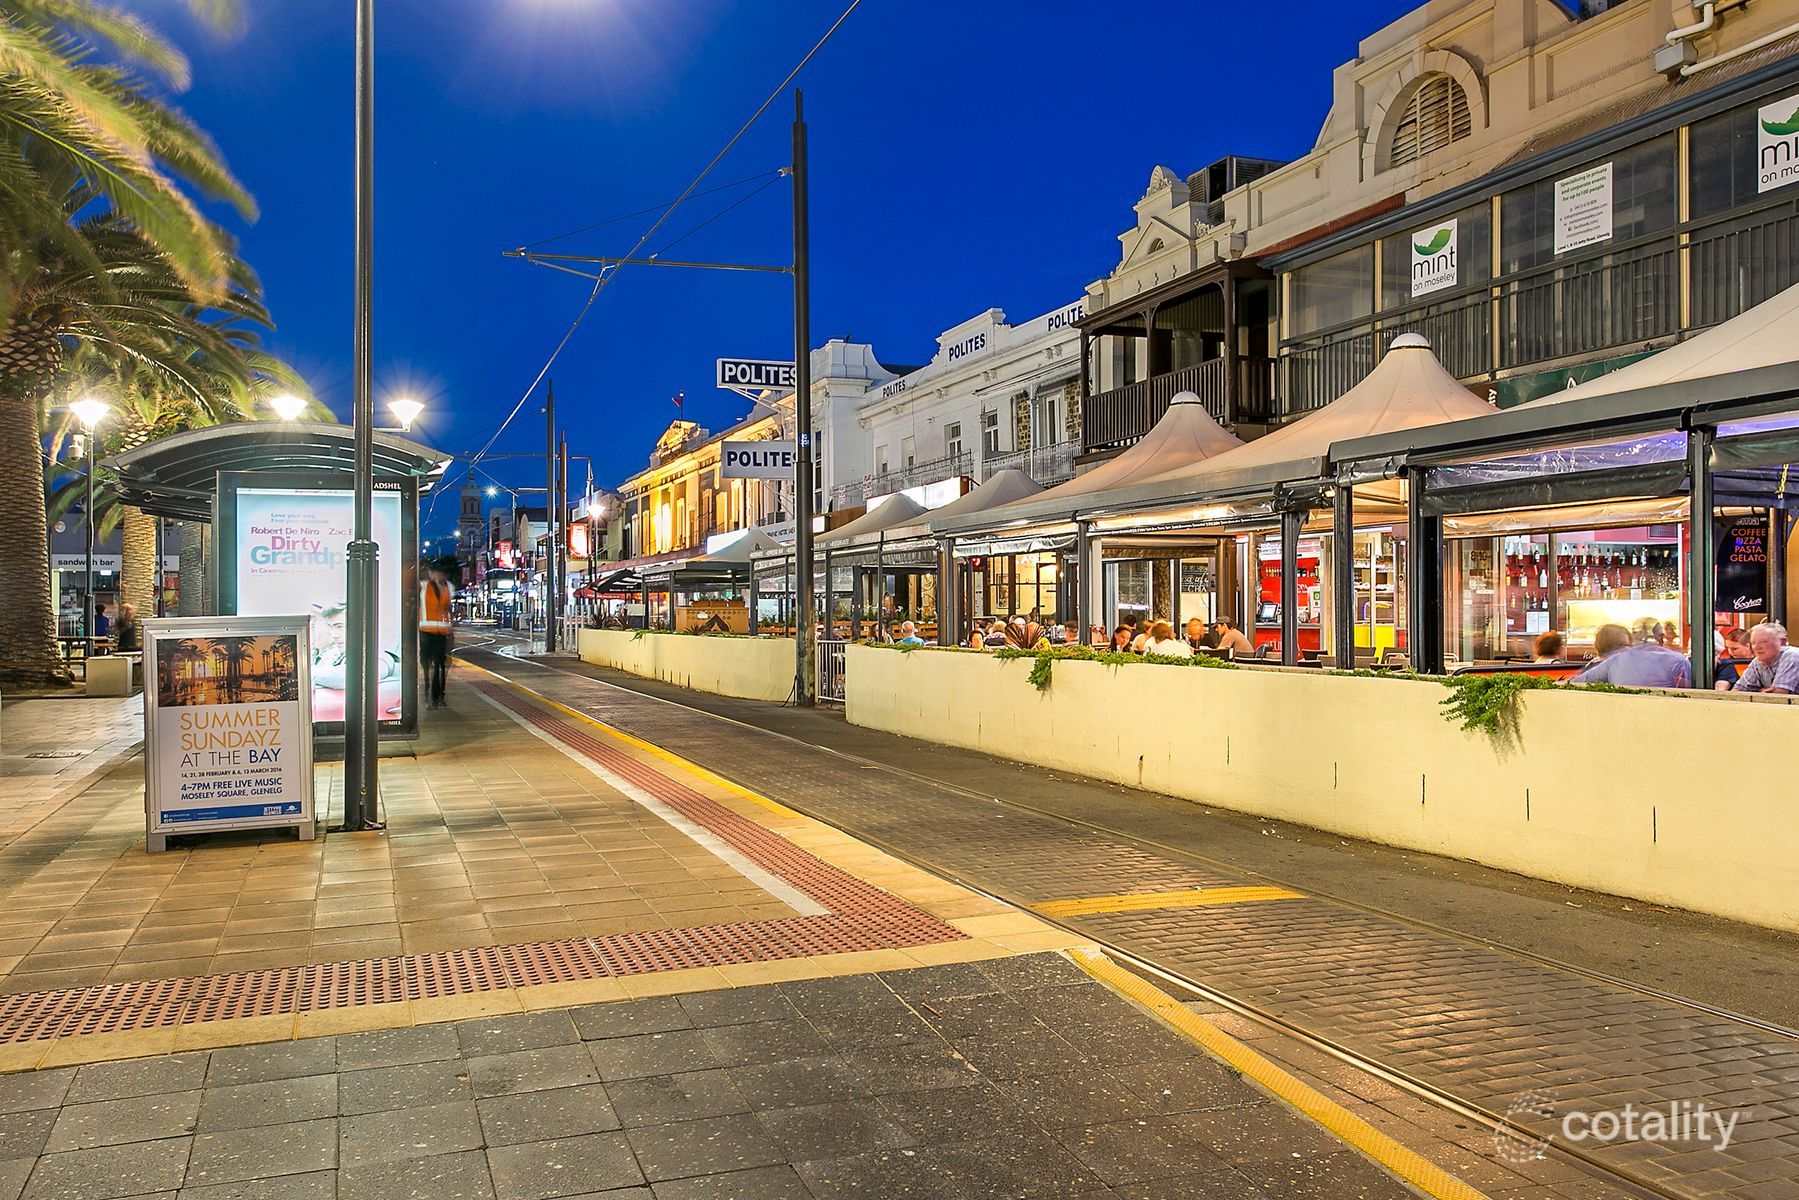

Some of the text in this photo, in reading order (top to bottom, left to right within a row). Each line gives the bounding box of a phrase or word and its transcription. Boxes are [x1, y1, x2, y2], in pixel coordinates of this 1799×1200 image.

[1761, 172, 1777, 183] on
[1414, 246, 1455, 280] mint
[1414, 273, 1455, 291] on moseley
[1048, 305, 1087, 331] POLITE
[949, 333, 985, 361] POLITES
[882, 380, 906, 398] POLITES
[251, 527, 282, 535] Robert
[301, 527, 319, 535] Niro
[271, 536, 320, 555] Dirty
[1730, 554, 1767, 562] GELATO
[180, 709, 280, 730] SUMMER
[181, 729, 281, 750] SUNDAYZ
[181, 748, 281, 768] AT THE BAY
[213, 781, 232, 789] FREE
[235, 780, 252, 788] LIVE
[255, 778, 282, 786] MUSIC
[181, 787, 282, 800] MOSELEY SQUARE, GLENELG
